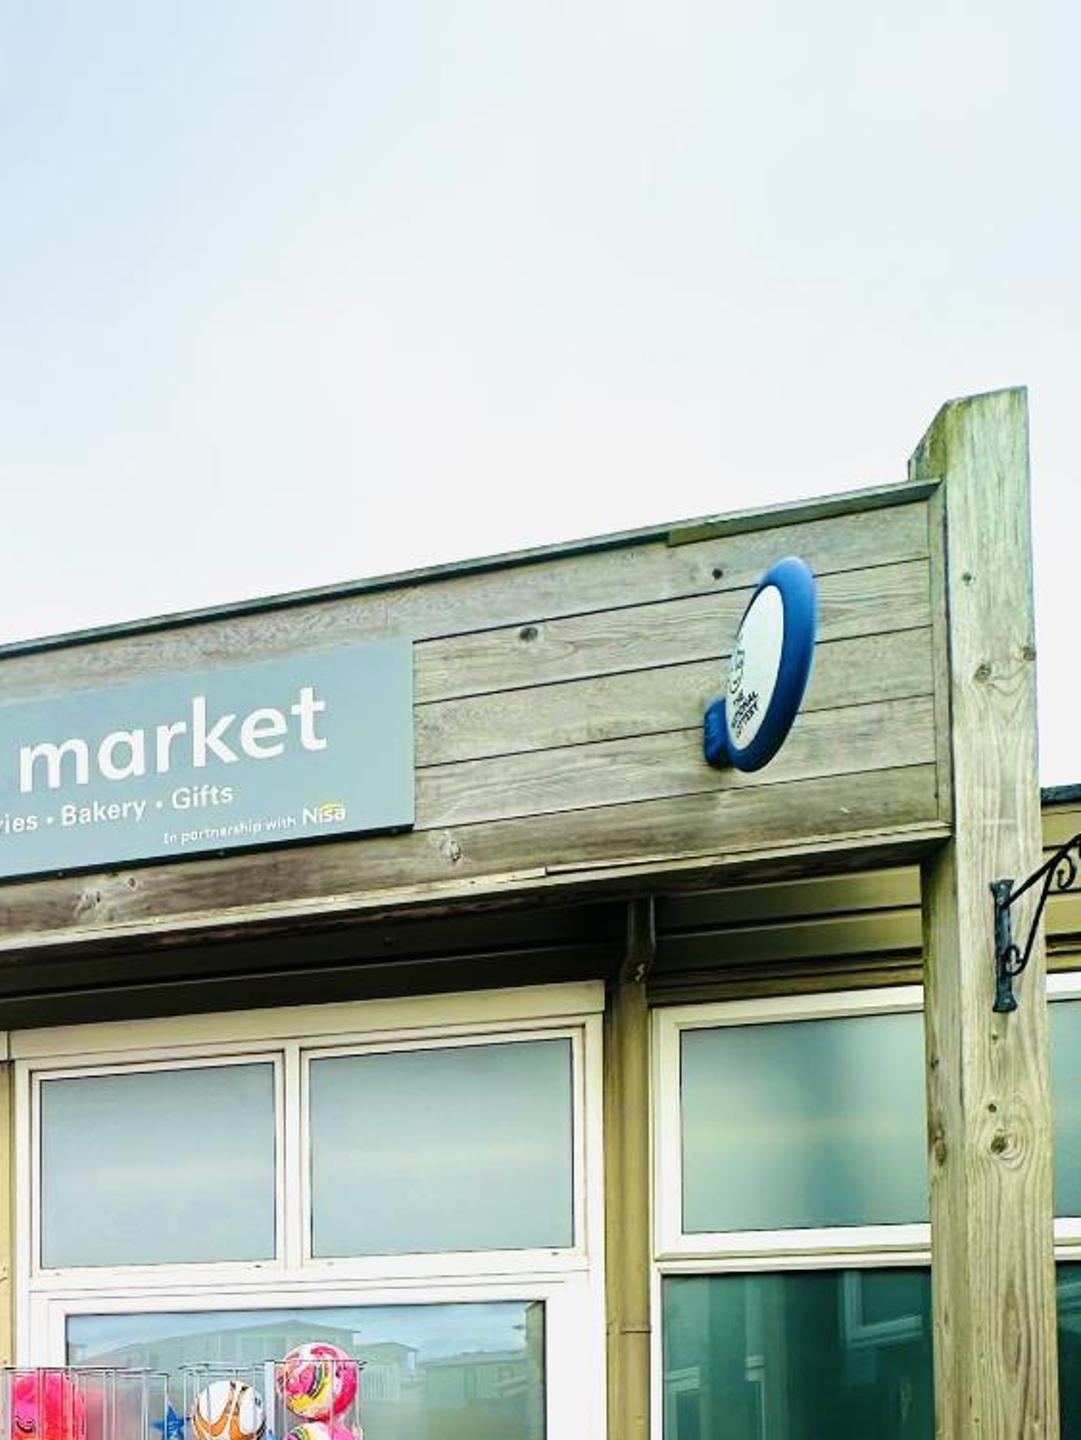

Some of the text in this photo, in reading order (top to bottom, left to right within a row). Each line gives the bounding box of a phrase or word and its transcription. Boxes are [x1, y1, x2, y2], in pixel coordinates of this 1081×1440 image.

[19, 686, 328, 793] market
[61, 800, 147, 827] Bakery
[172, 784, 234, 810] Gifts
[164, 803, 347, 845] In partnership with Nisa
